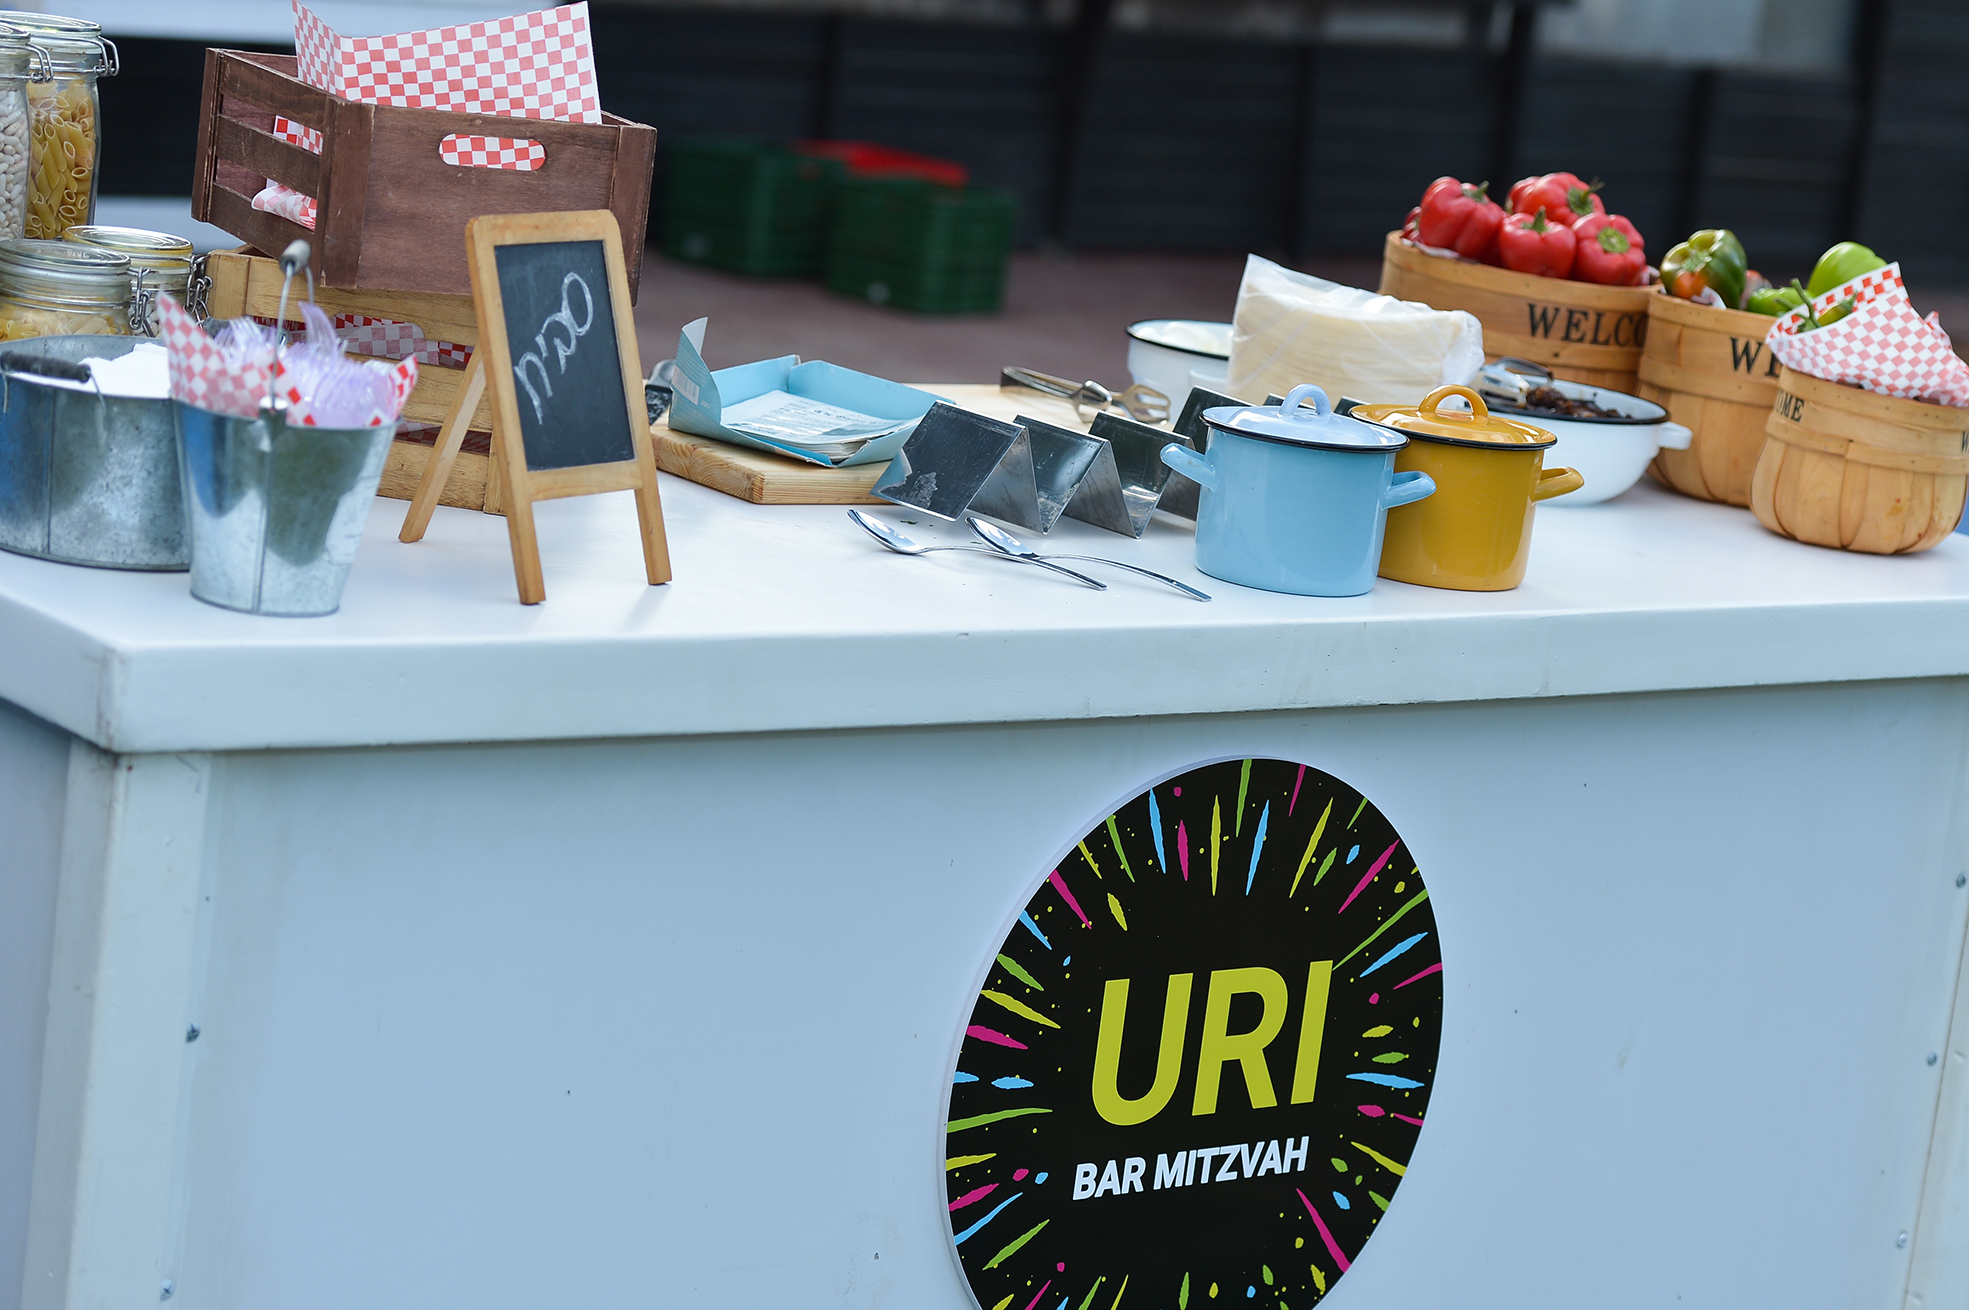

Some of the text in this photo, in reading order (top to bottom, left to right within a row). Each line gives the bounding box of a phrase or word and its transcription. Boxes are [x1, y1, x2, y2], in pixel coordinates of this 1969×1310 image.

[1092, 960, 1333, 1126] URI
[1072, 1136, 1310, 1200] BAR MITZVAH
